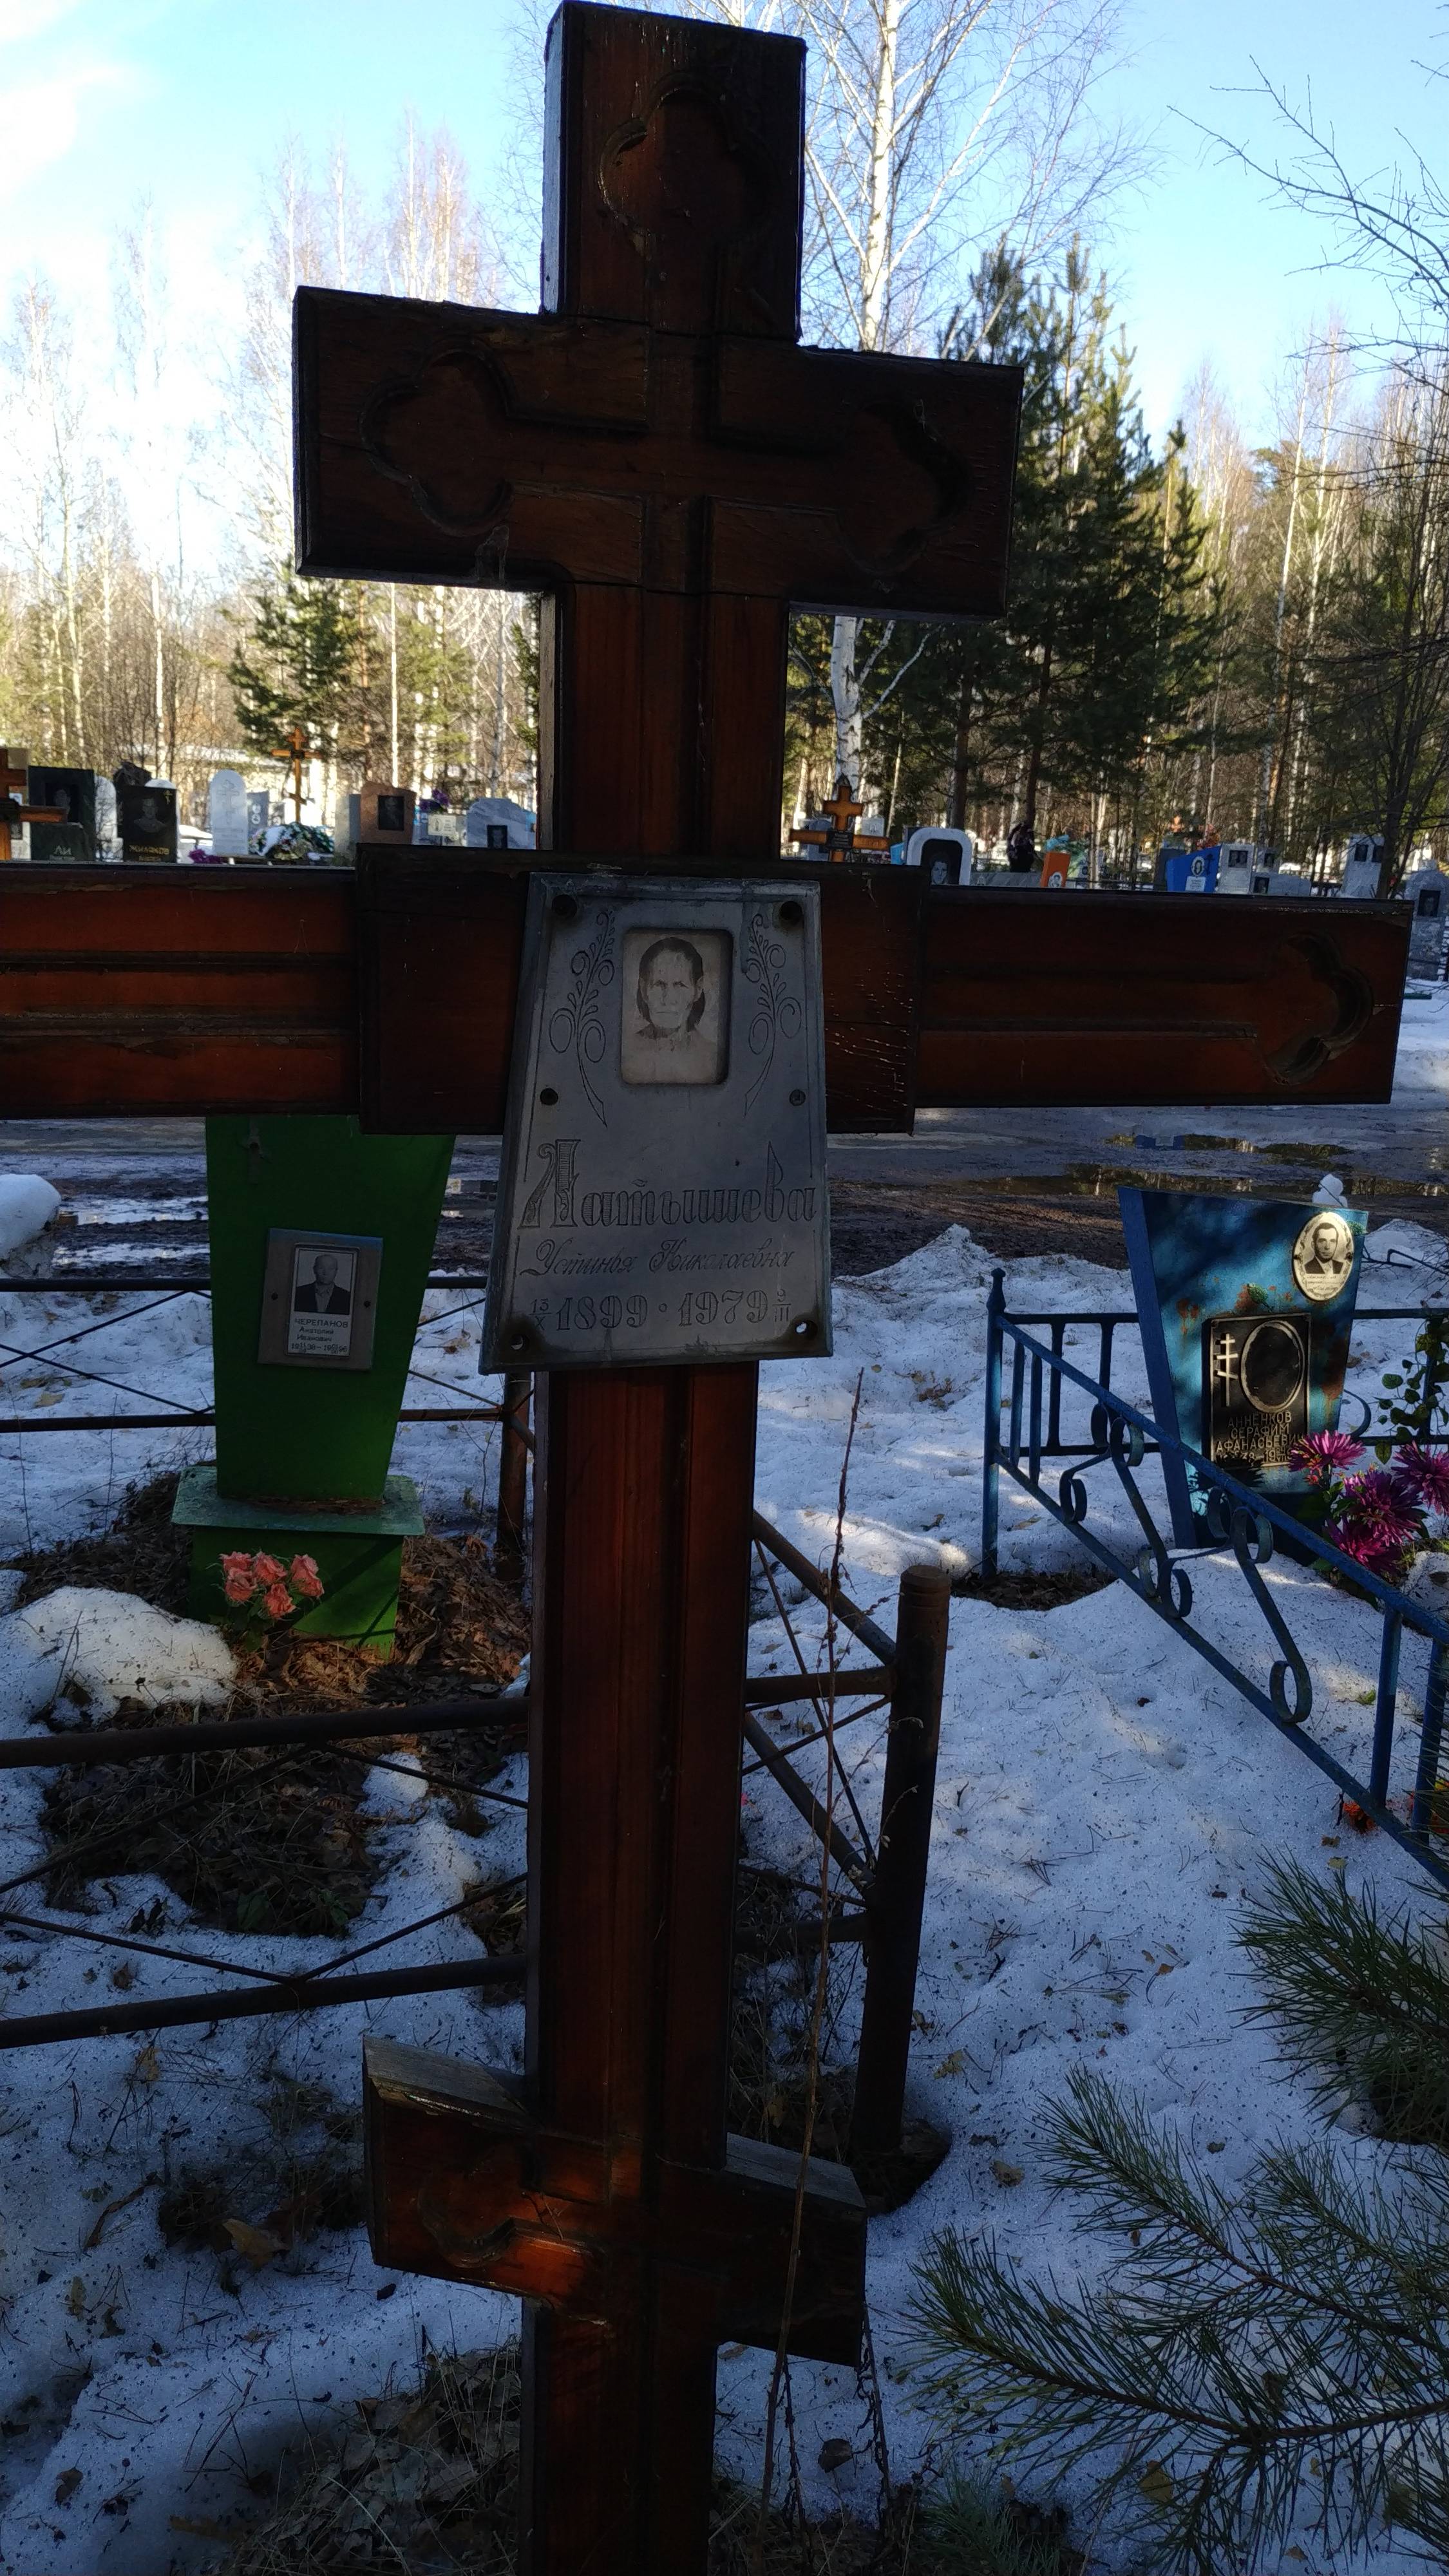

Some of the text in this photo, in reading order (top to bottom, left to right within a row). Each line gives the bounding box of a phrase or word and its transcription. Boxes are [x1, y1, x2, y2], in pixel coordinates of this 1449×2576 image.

[518, 1139, 817, 1229] Латышева
[519, 1237, 638, 1276] Устинья
[556, 1290, 768, 1331] 1899 1979
[295, 1318, 348, 1328] ЧЕРЕПАНОВ
[299, 1326, 334, 1334] Анатолий
[1227, 1411, 1292, 1427] АННЕНКОВ
[1231, 1423, 1289, 1439] СЕРАФИМ
